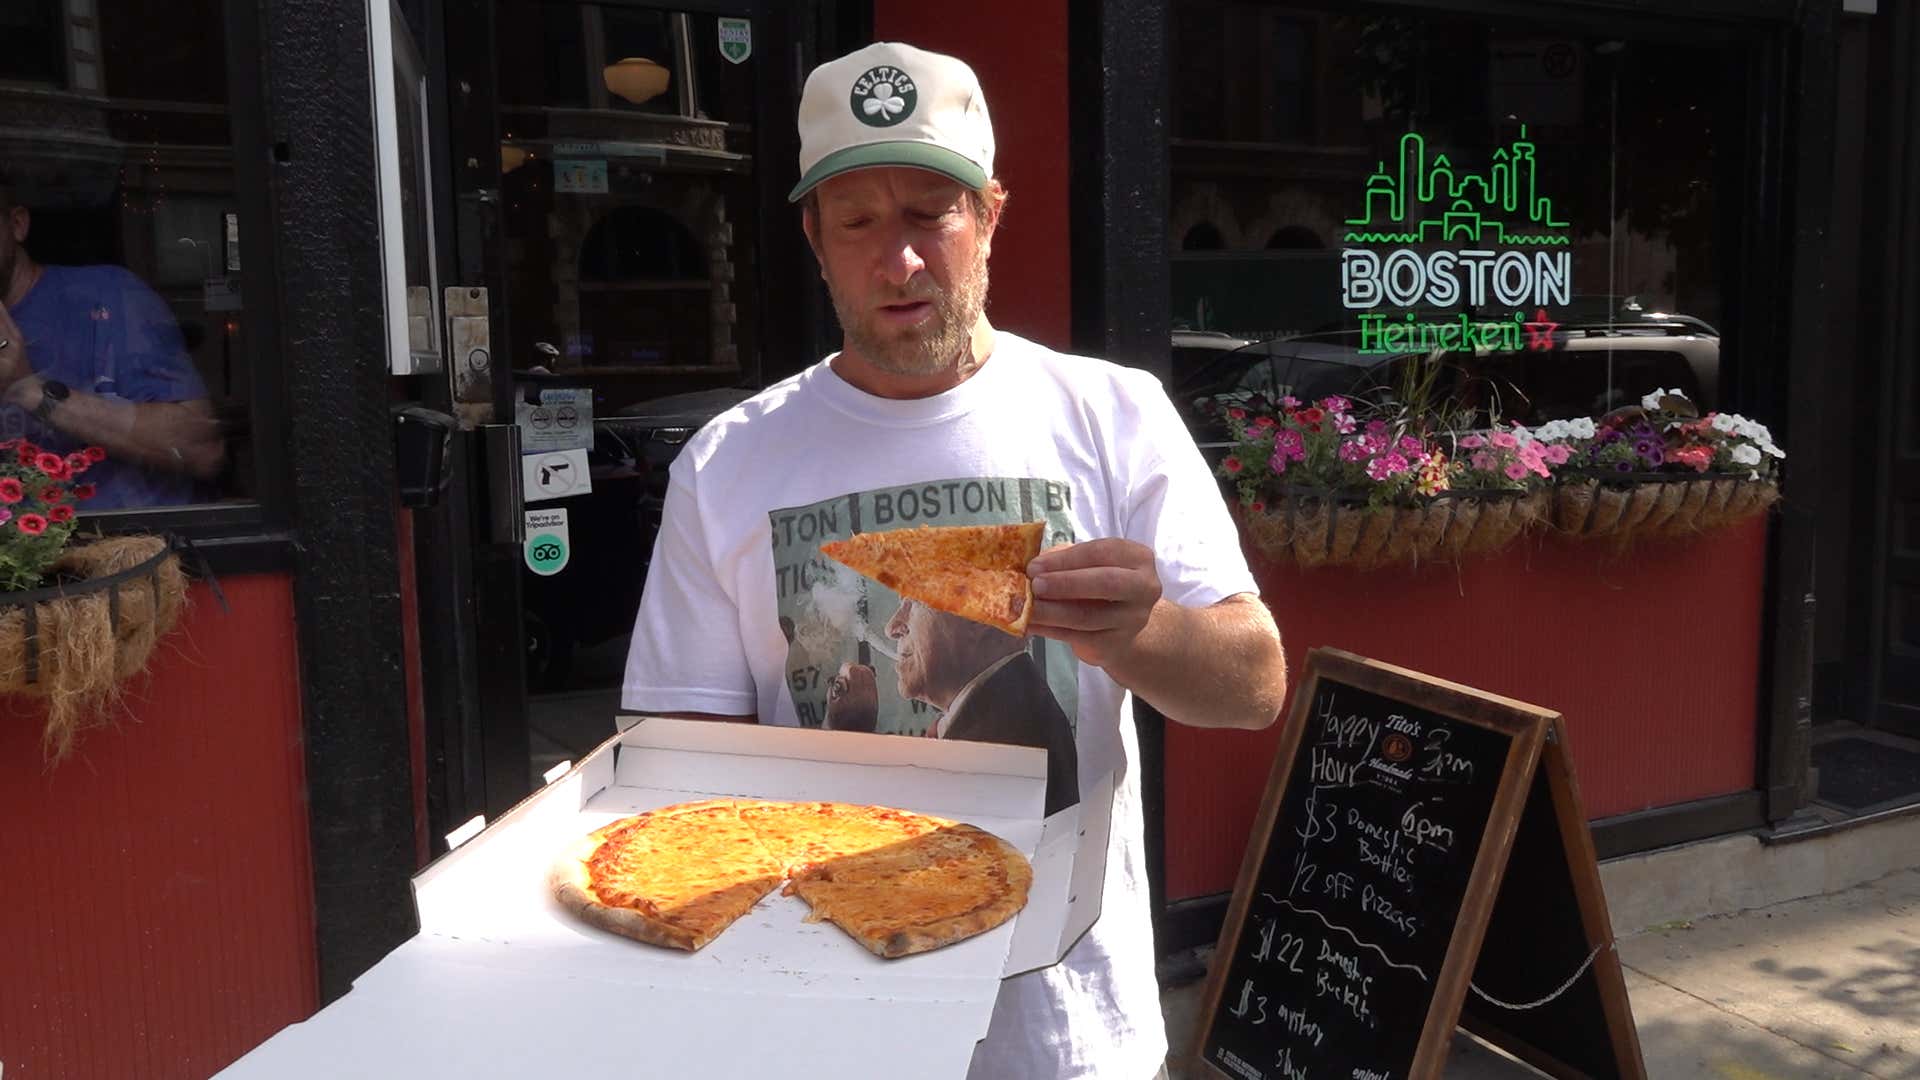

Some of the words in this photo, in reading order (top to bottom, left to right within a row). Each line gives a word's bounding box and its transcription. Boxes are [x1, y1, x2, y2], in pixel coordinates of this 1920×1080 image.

[854, 67, 914, 96] CELTICS
[1342, 248, 1571, 309] BOSTON
[1358, 312, 1524, 354] Heineken
[874, 480, 1006, 525] BOSTON
[1318, 692, 1381, 760] Happy
[1385, 713, 1421, 737] Tito's
[1310, 746, 1367, 788] Hour
[1296, 795, 1337, 847] $3
[1348, 808, 1416, 865] Domestic
[1401, 801, 1453, 846] 6pm
